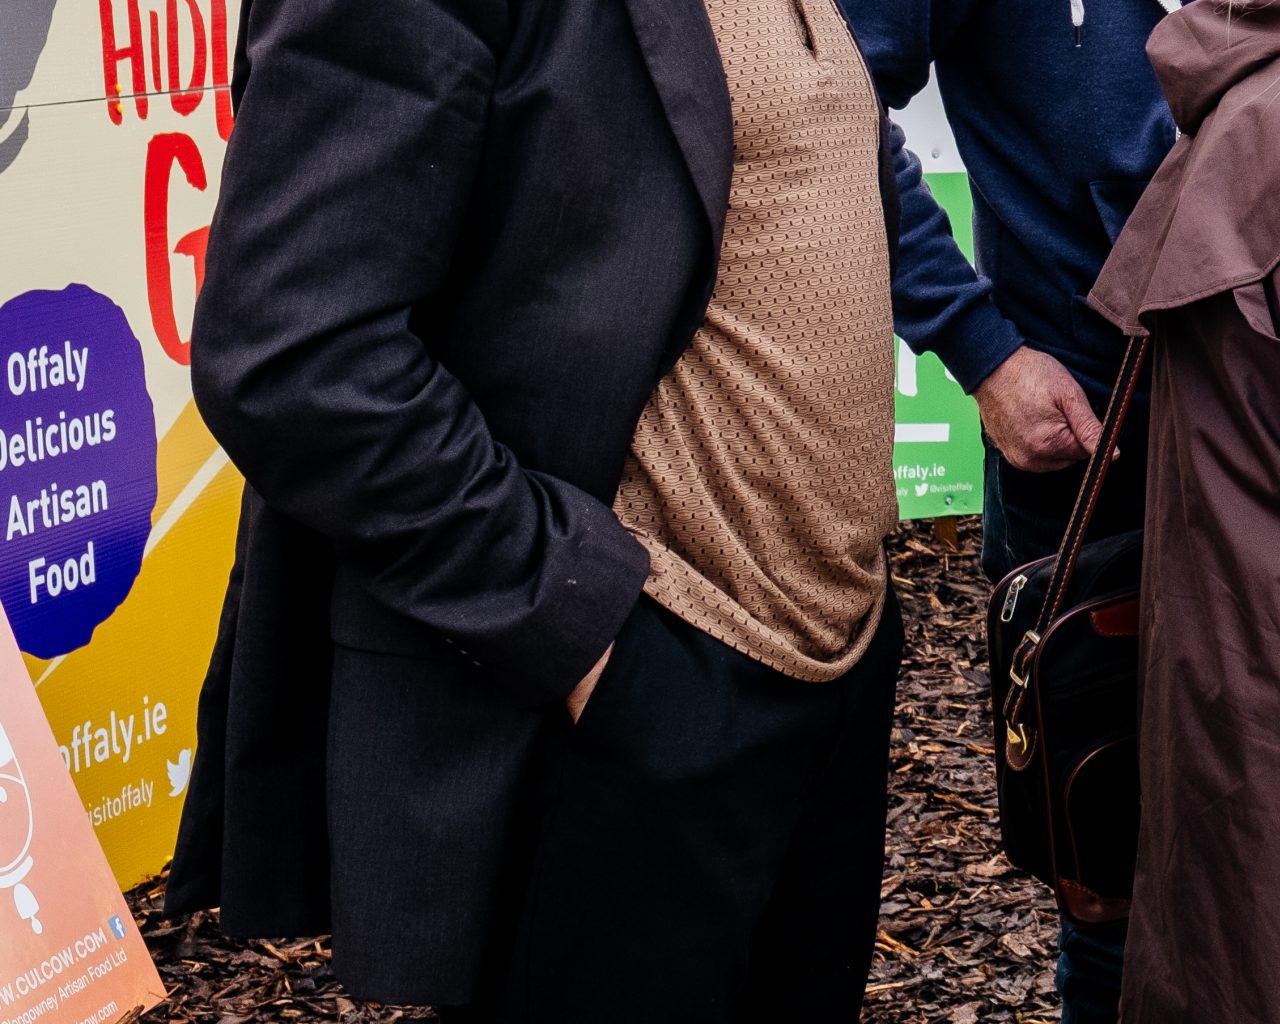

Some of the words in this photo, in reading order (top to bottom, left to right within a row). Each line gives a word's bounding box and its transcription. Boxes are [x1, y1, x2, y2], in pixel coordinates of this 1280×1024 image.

[7, 340, 89, 396] Offaly
[6, 479, 108, 541] Artisan
[28, 541, 96, 605] Food
[87, 777, 154, 827] isitoffaly
[0, 927, 108, 1010] W.CULCOW.COM
[58, 974, 91, 1001] Artisan
[87, 956, 113, 982] Food
[110, 947, 128, 968] Ltd
